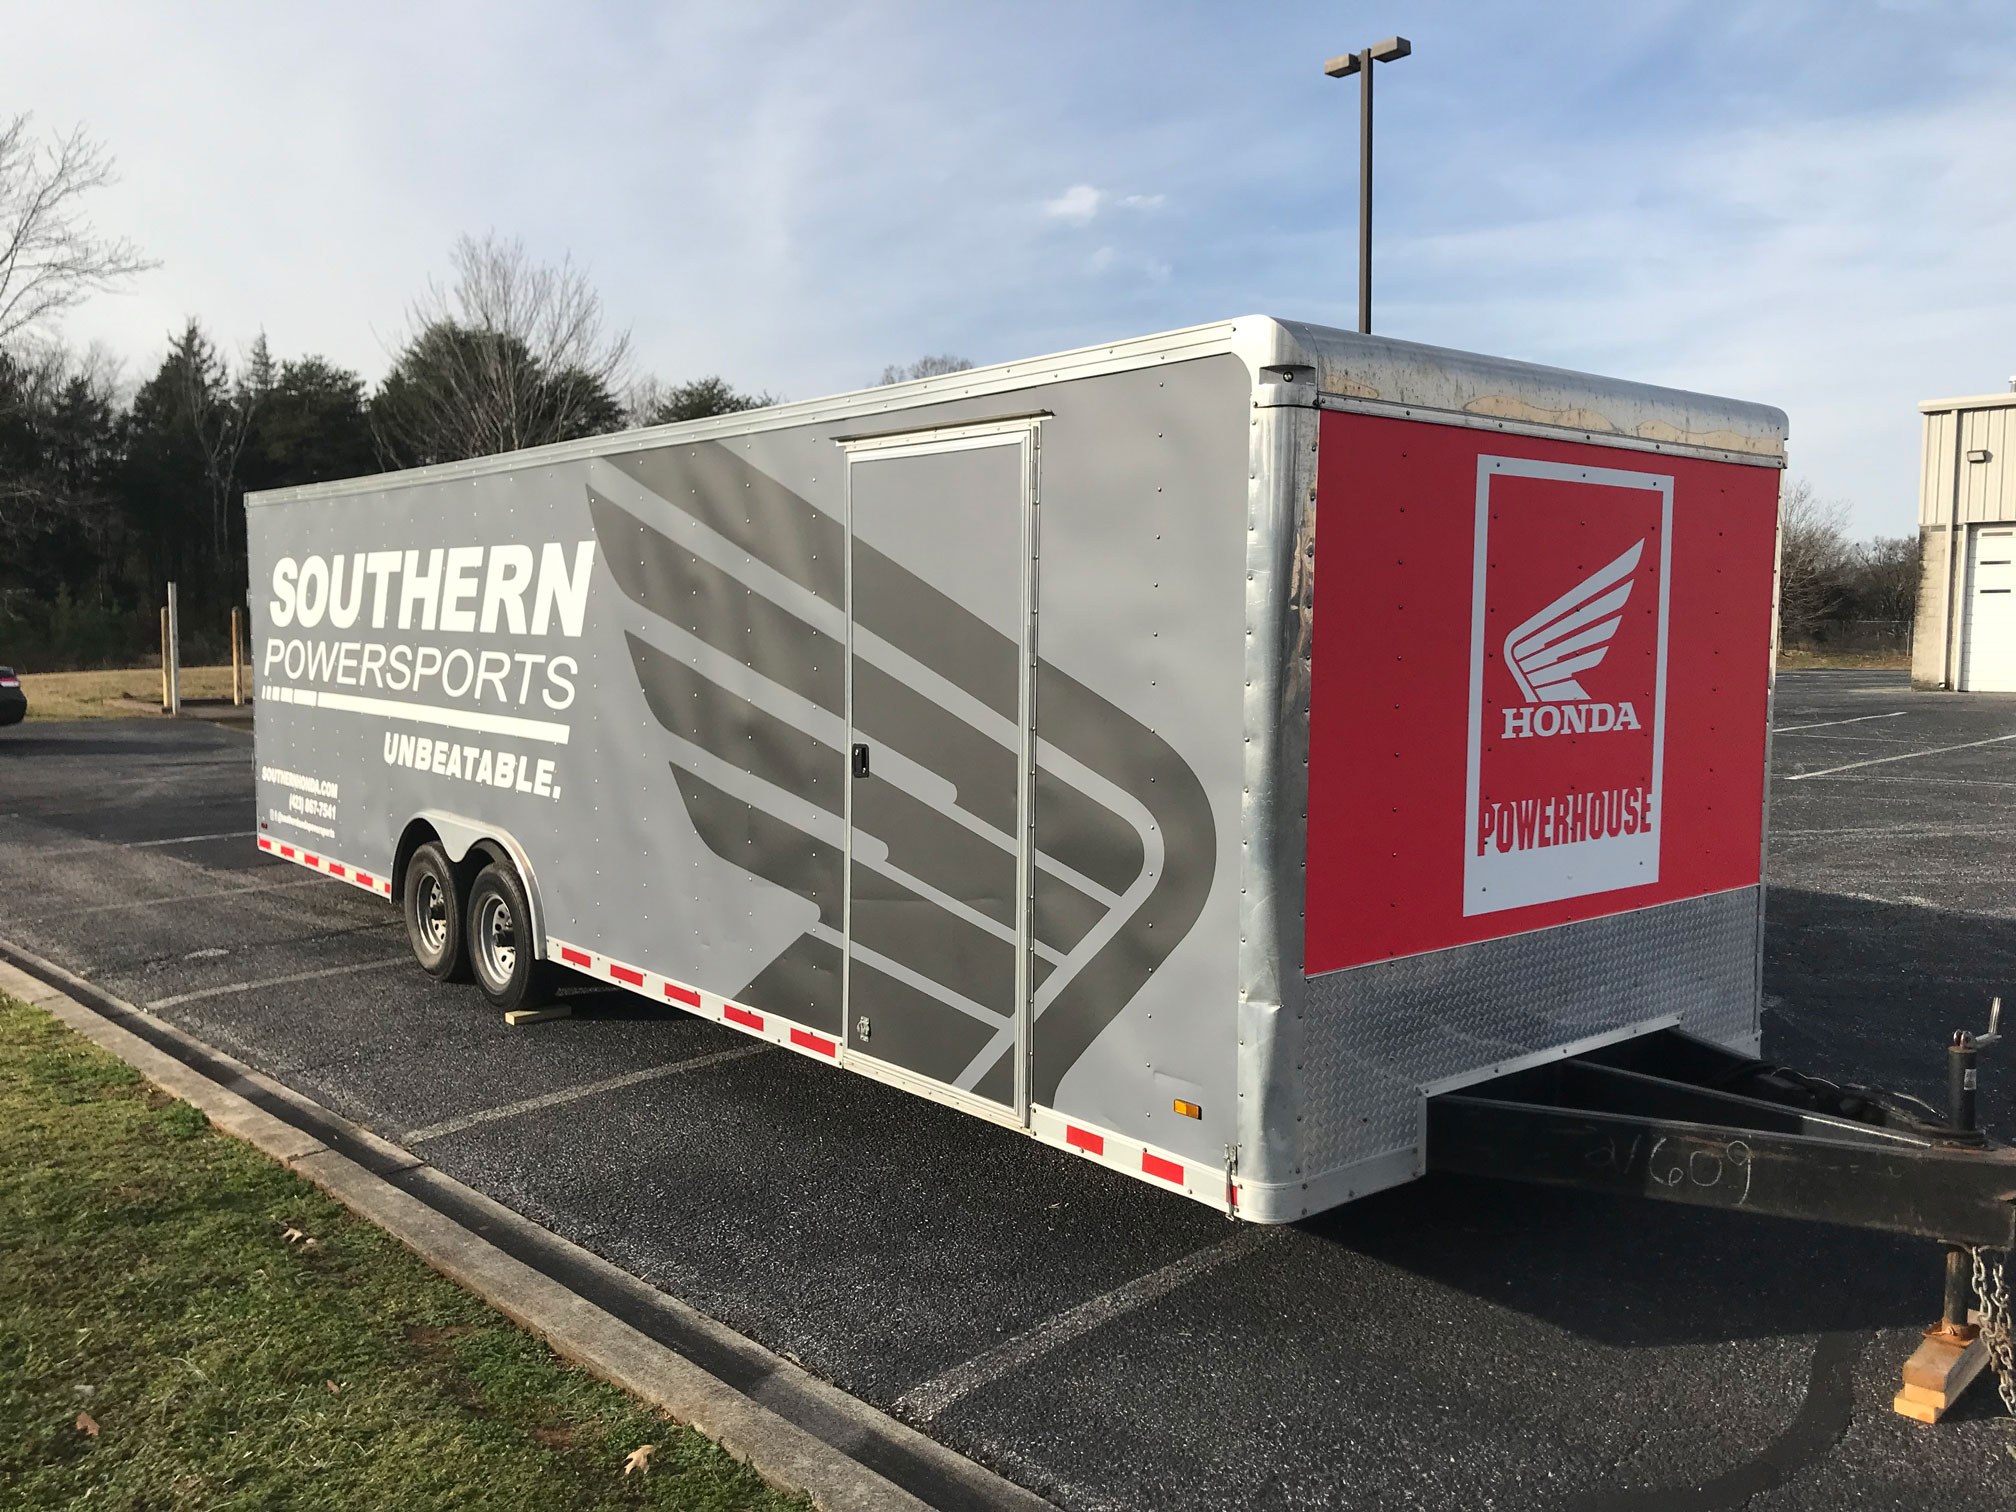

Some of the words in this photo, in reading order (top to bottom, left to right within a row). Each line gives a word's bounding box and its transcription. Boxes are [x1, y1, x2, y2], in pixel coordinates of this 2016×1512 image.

[269, 540, 596, 638] SOUTHERN
[263, 637, 578, 710] POWERSPORTS
[1501, 702, 1641, 739] HONDA
[384, 731, 561, 799] UNBEATABLE.
[1477, 787, 1653, 856] POWERHOUSE
